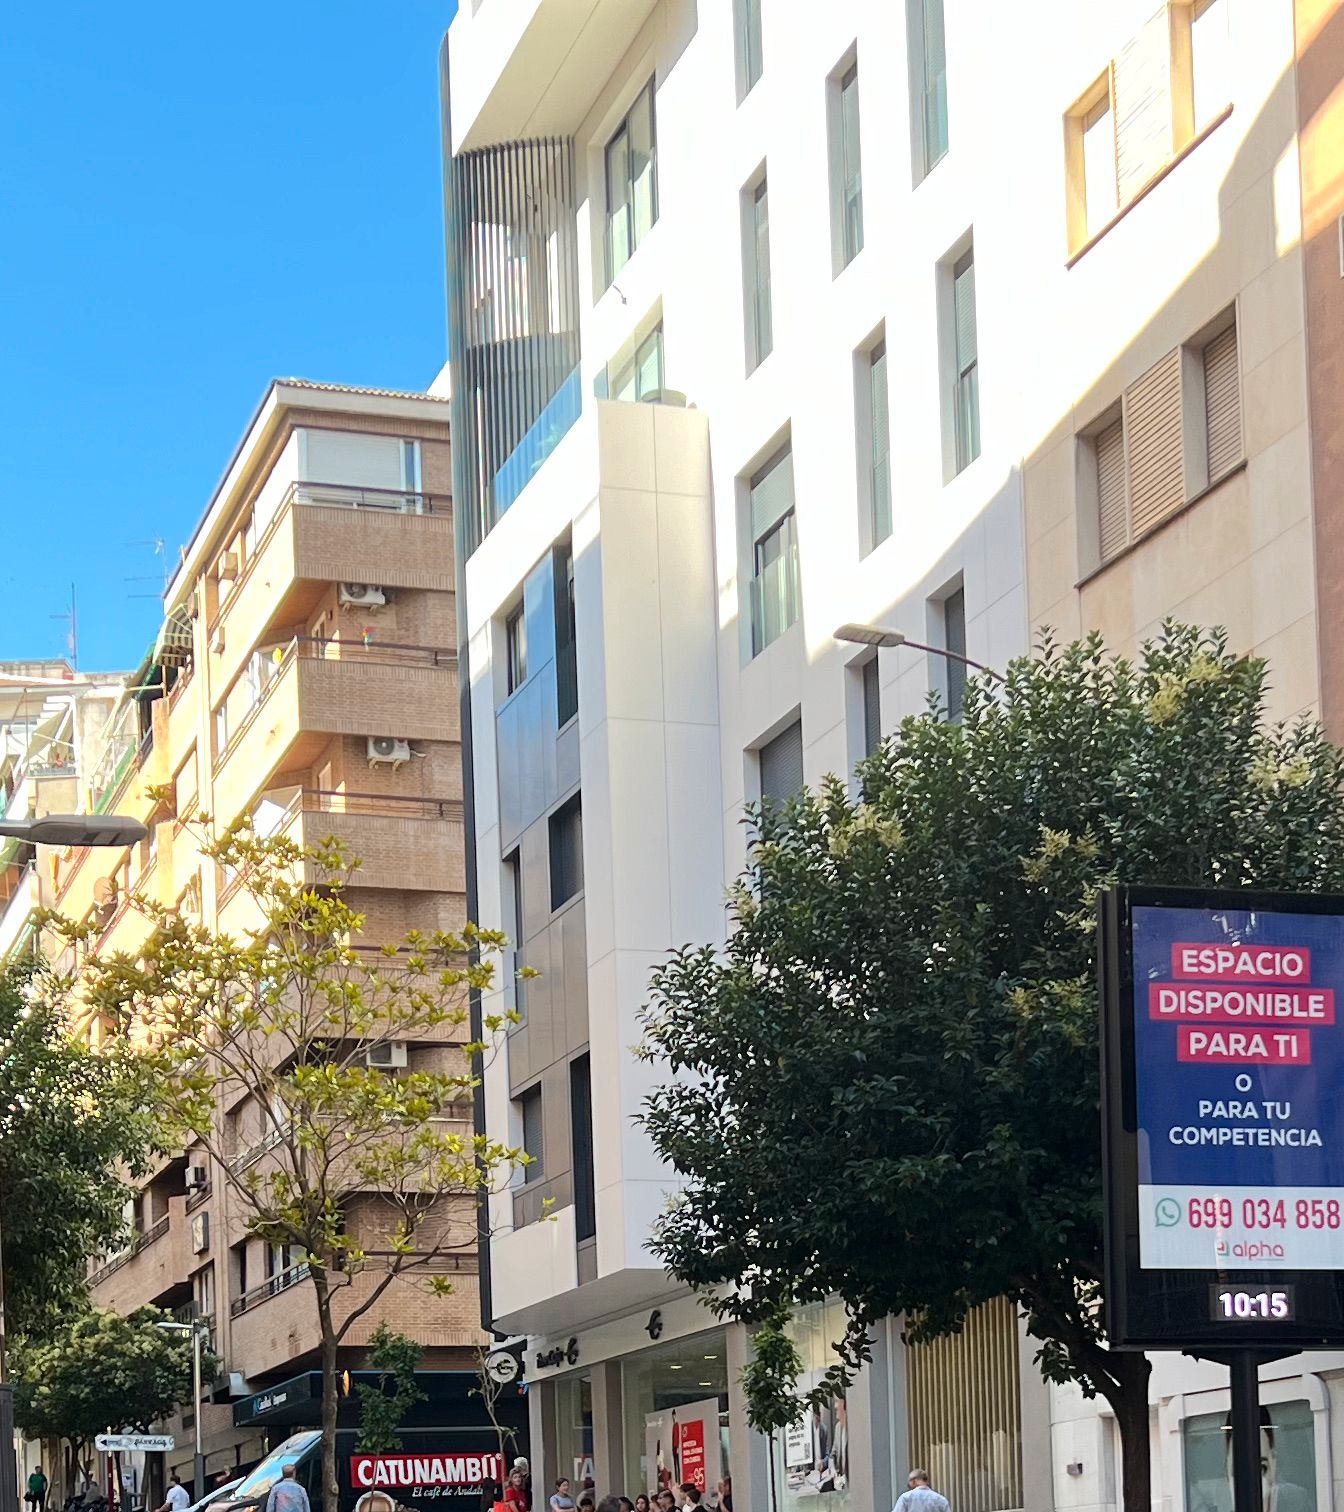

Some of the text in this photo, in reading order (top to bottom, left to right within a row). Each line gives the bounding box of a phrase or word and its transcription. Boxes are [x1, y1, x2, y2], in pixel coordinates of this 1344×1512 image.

[1182, 949, 1304, 977] ESPACIO
[1159, 990, 1326, 1018] DISPONIBLE
[1189, 1031, 1299, 1058] PARA TI
[1235, 1073, 1253, 1092] O
[1198, 1100, 1291, 1120] PARA TU
[1169, 1126, 1323, 1147] COMPETENCIA
[1188, 1198, 1341, 1230] 699 034 858
[1232, 1240, 1284, 1260] alpha
[1218, 1292, 1288, 1318] 10:15
[358, 1454, 497, 1486] CATUNAMBÚ
[412, 1487, 422, 1497] El
[423, 1486, 442, 1499] café
[442, 1486, 453, 1496] de
